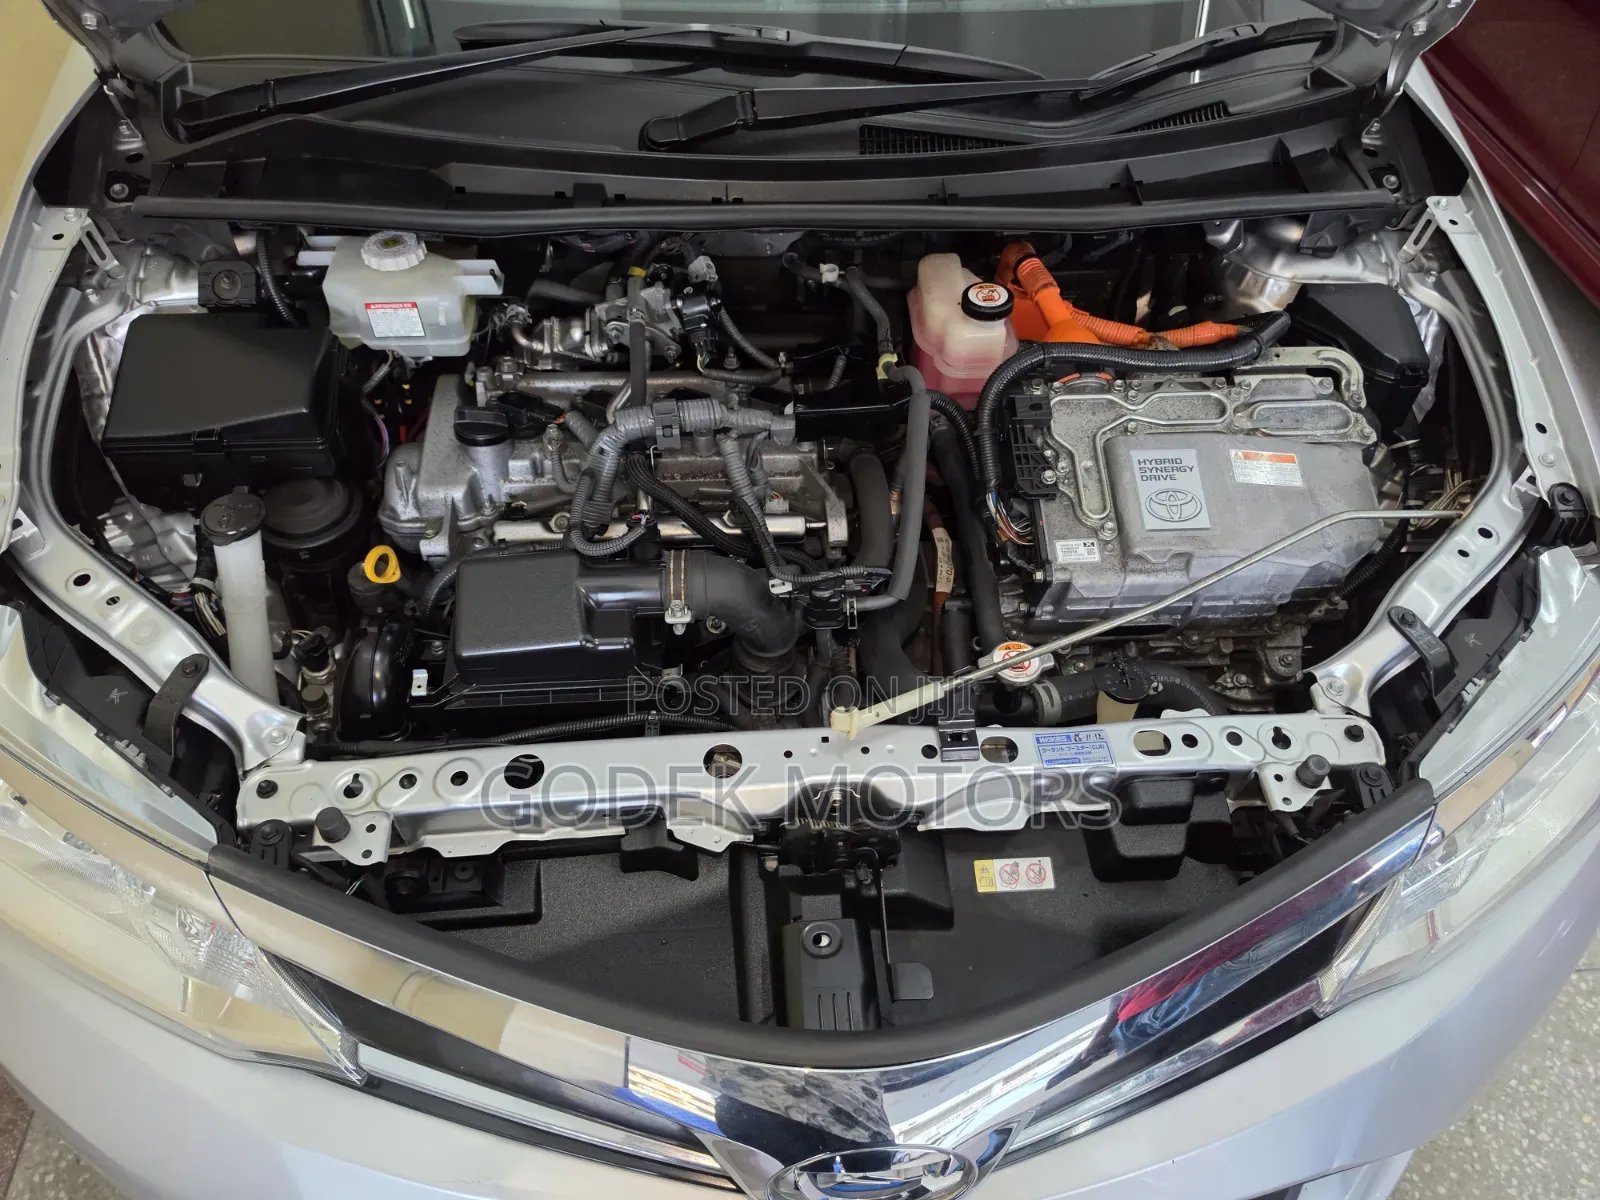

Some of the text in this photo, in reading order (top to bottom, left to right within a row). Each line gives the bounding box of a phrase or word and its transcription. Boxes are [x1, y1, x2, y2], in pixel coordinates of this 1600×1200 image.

[1137, 458, 1183, 466] HYBRID
[1139, 465, 1194, 474] SYNERGY
[1140, 474, 1177, 482] DRIVE
